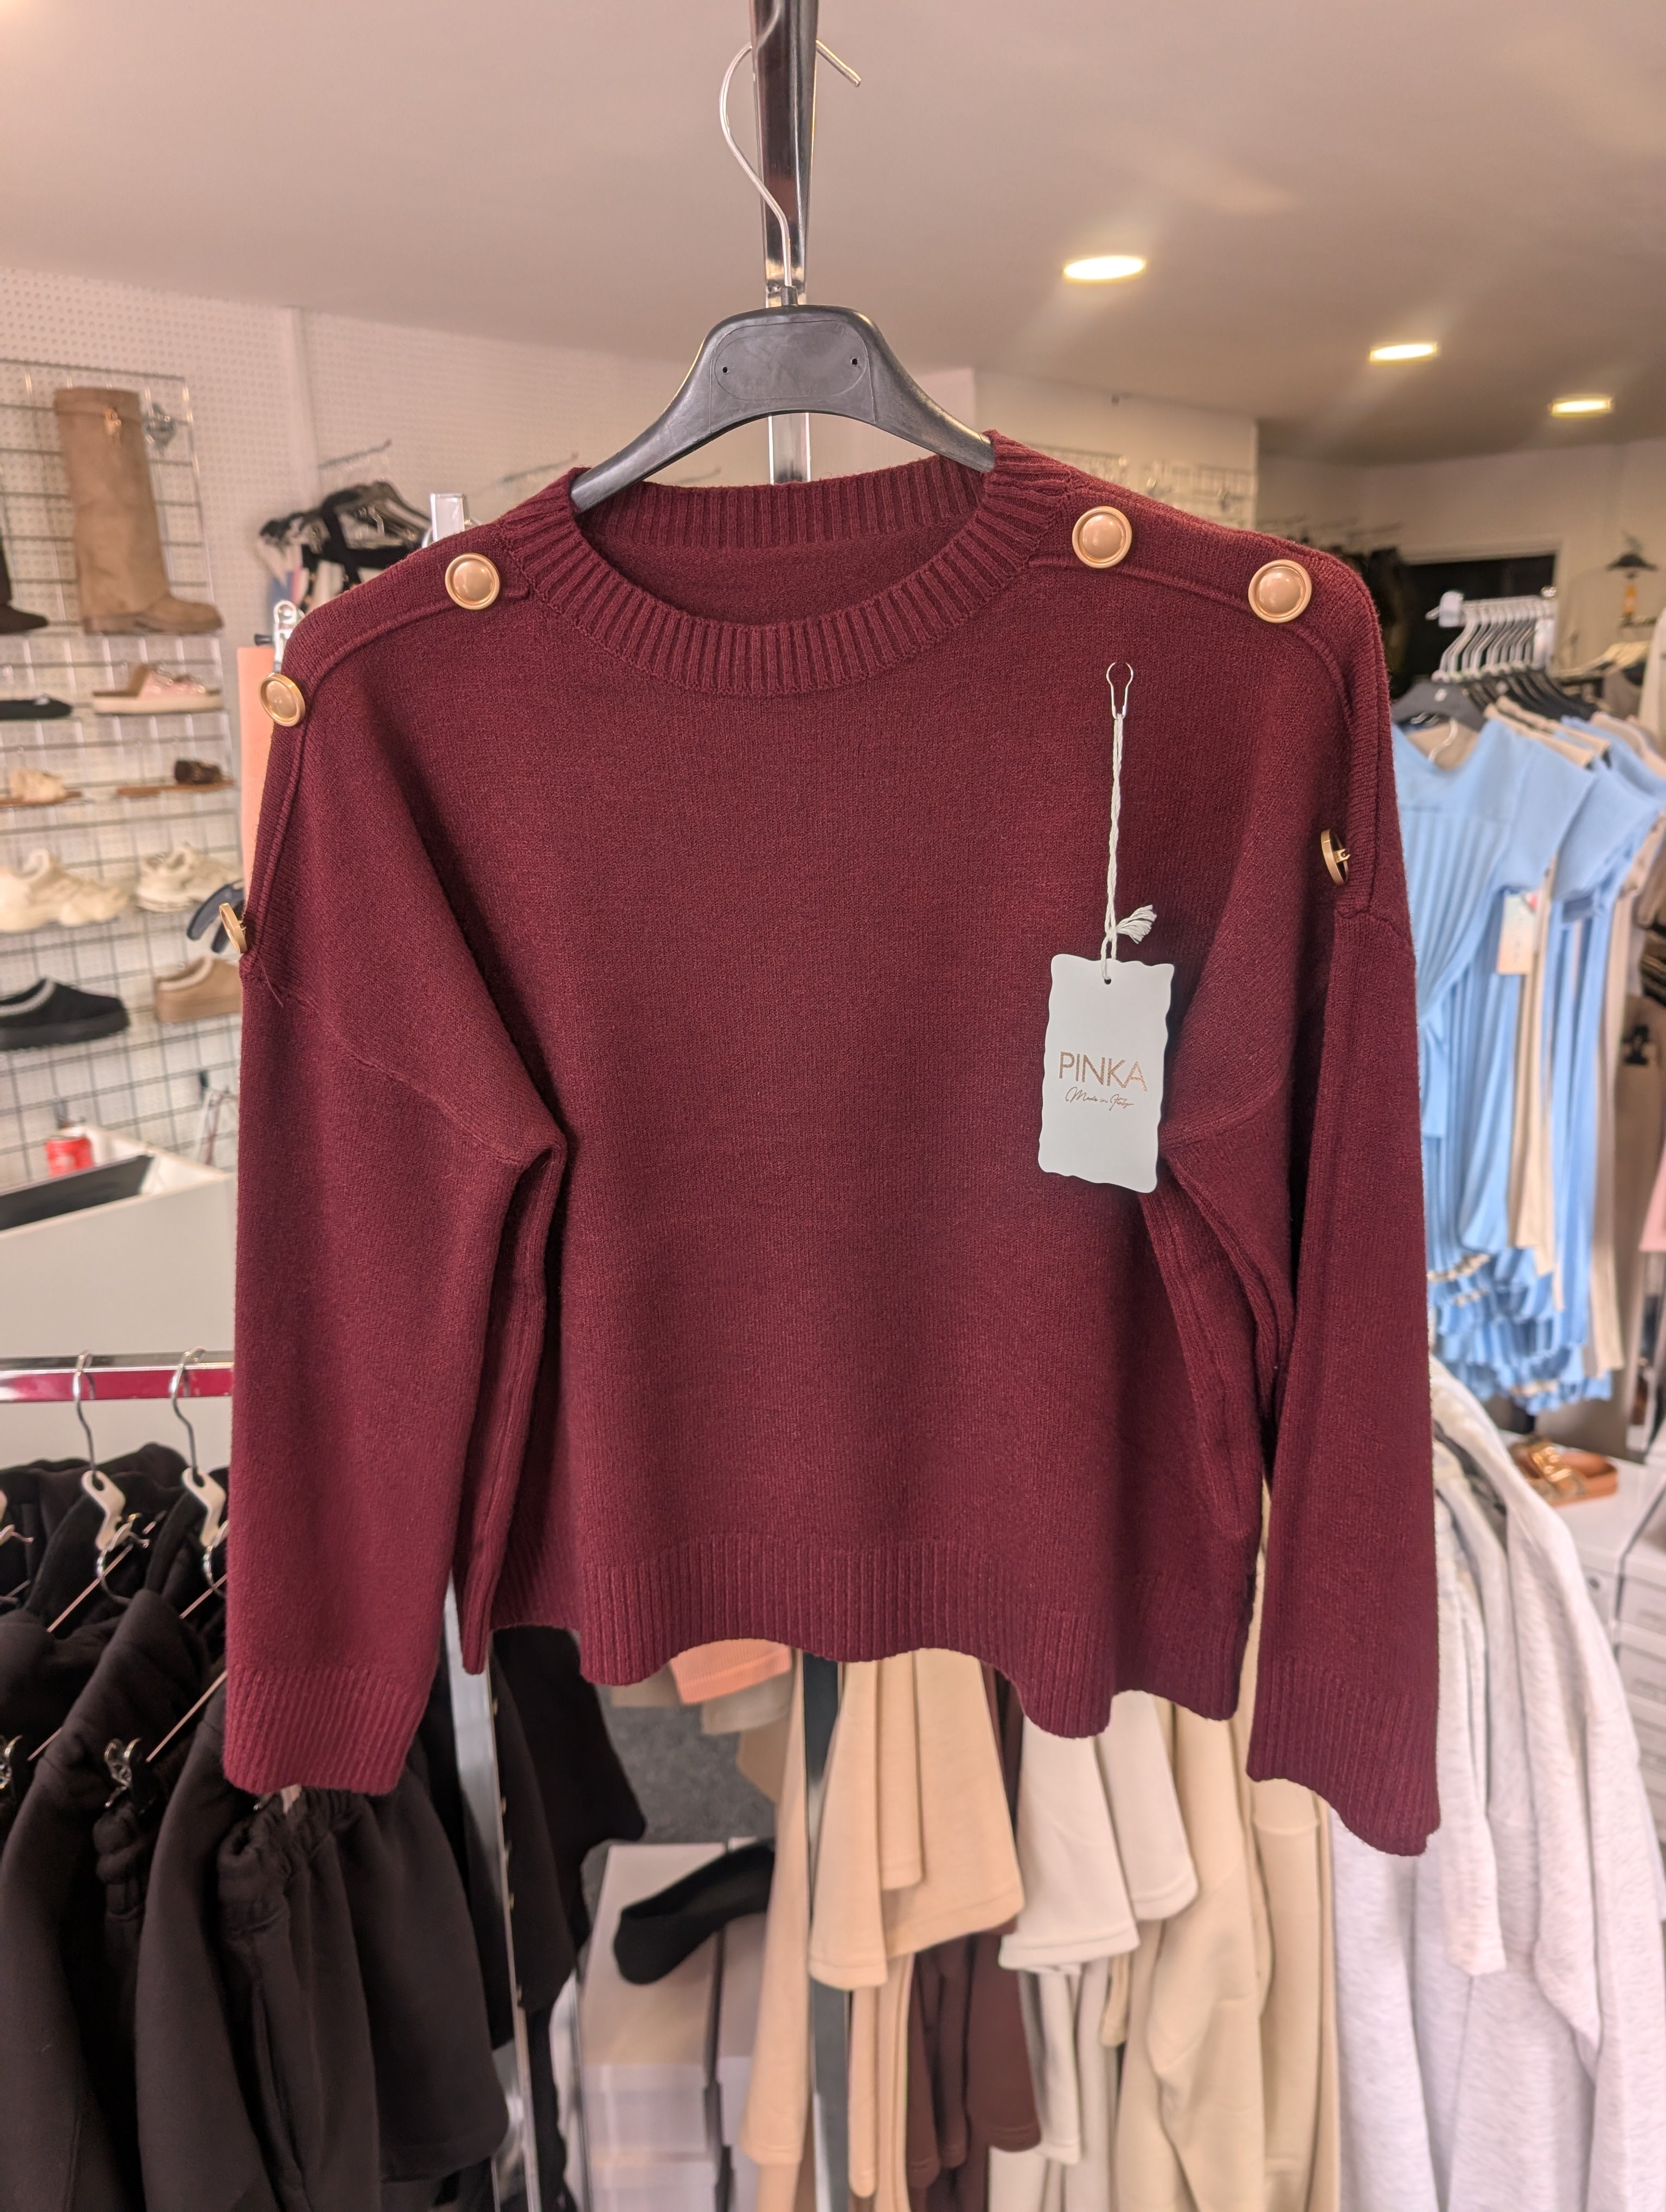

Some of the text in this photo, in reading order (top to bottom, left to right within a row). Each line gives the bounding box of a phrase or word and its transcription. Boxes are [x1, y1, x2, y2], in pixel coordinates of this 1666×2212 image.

[1059, 1051, 1148, 1091] PINKA
[1065, 1086, 1098, 1103] Made
[1109, 1094, 1135, 1111] Italy
